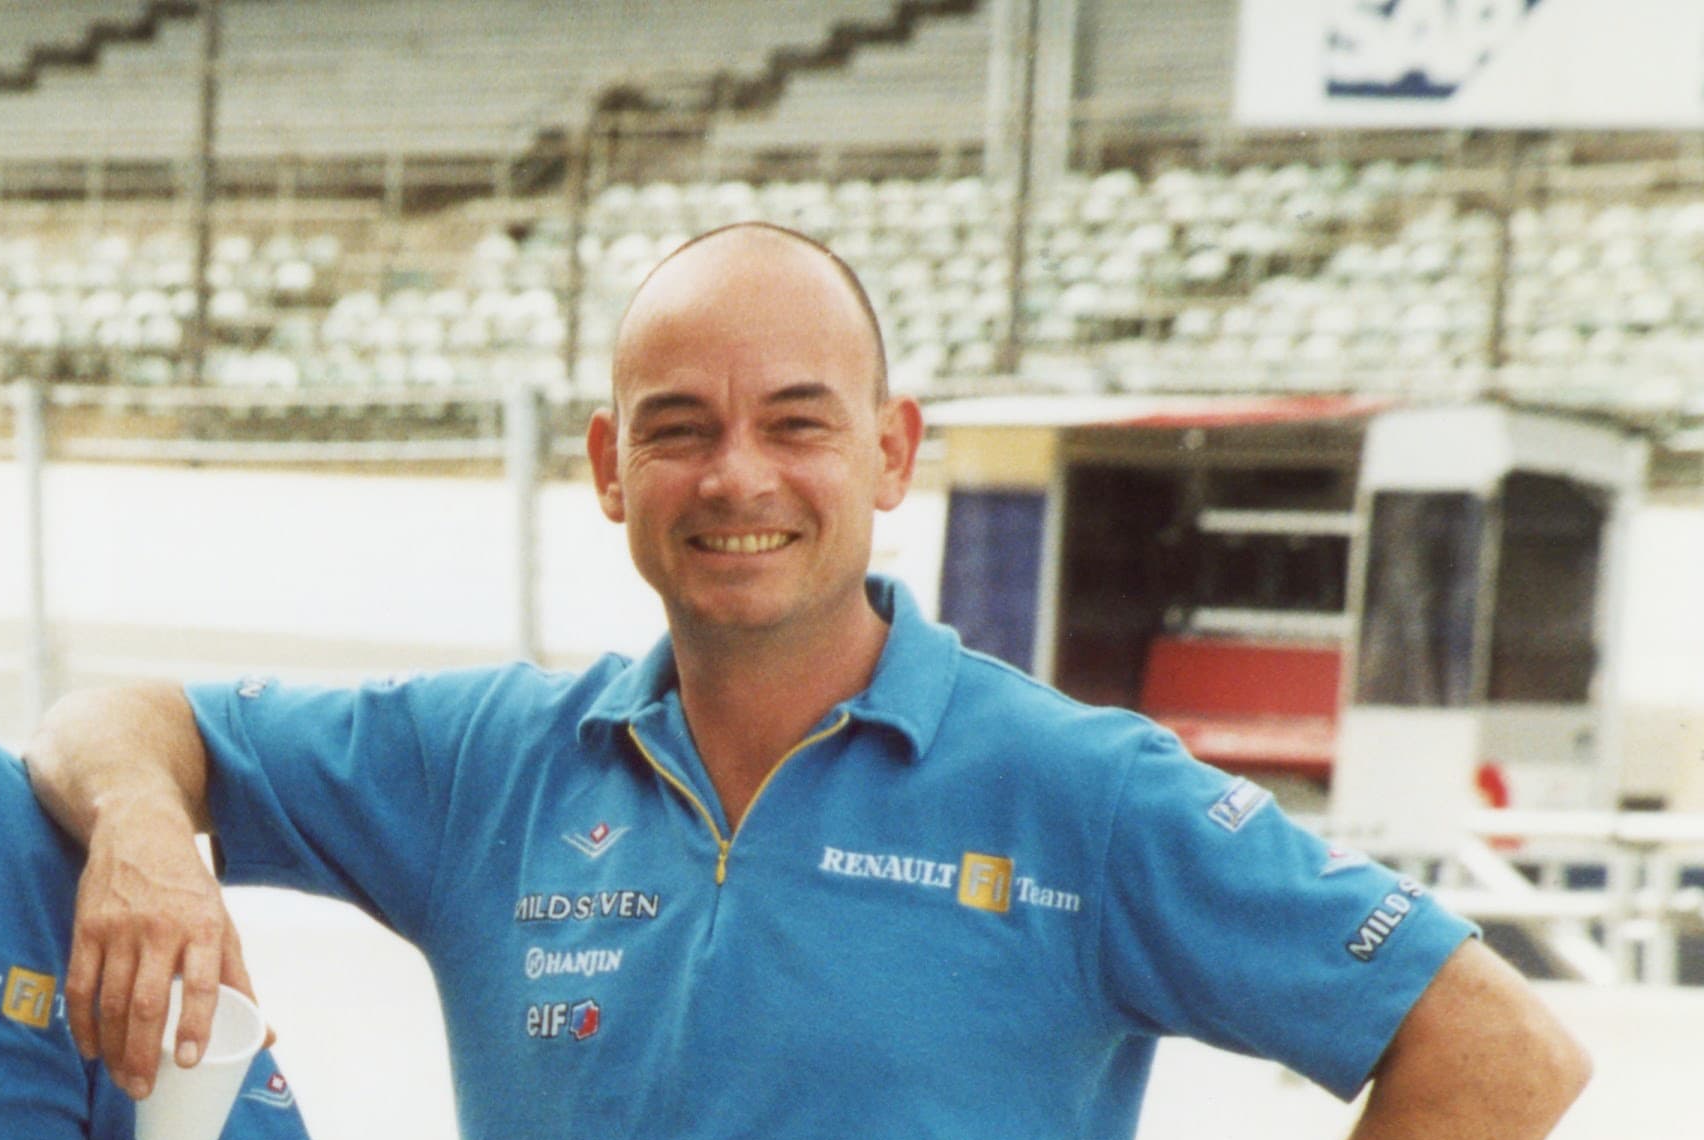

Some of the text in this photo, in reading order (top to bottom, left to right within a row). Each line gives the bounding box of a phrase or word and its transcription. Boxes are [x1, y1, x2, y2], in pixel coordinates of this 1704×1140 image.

[818, 846, 958, 888] RENAULT
[1014, 877, 1081, 912] Team
[574, 891, 659, 921] SVEN
[1347, 892, 1414, 962] MILD
[546, 949, 624, 977] HANJIN
[526, 1003, 567, 1038] elf
